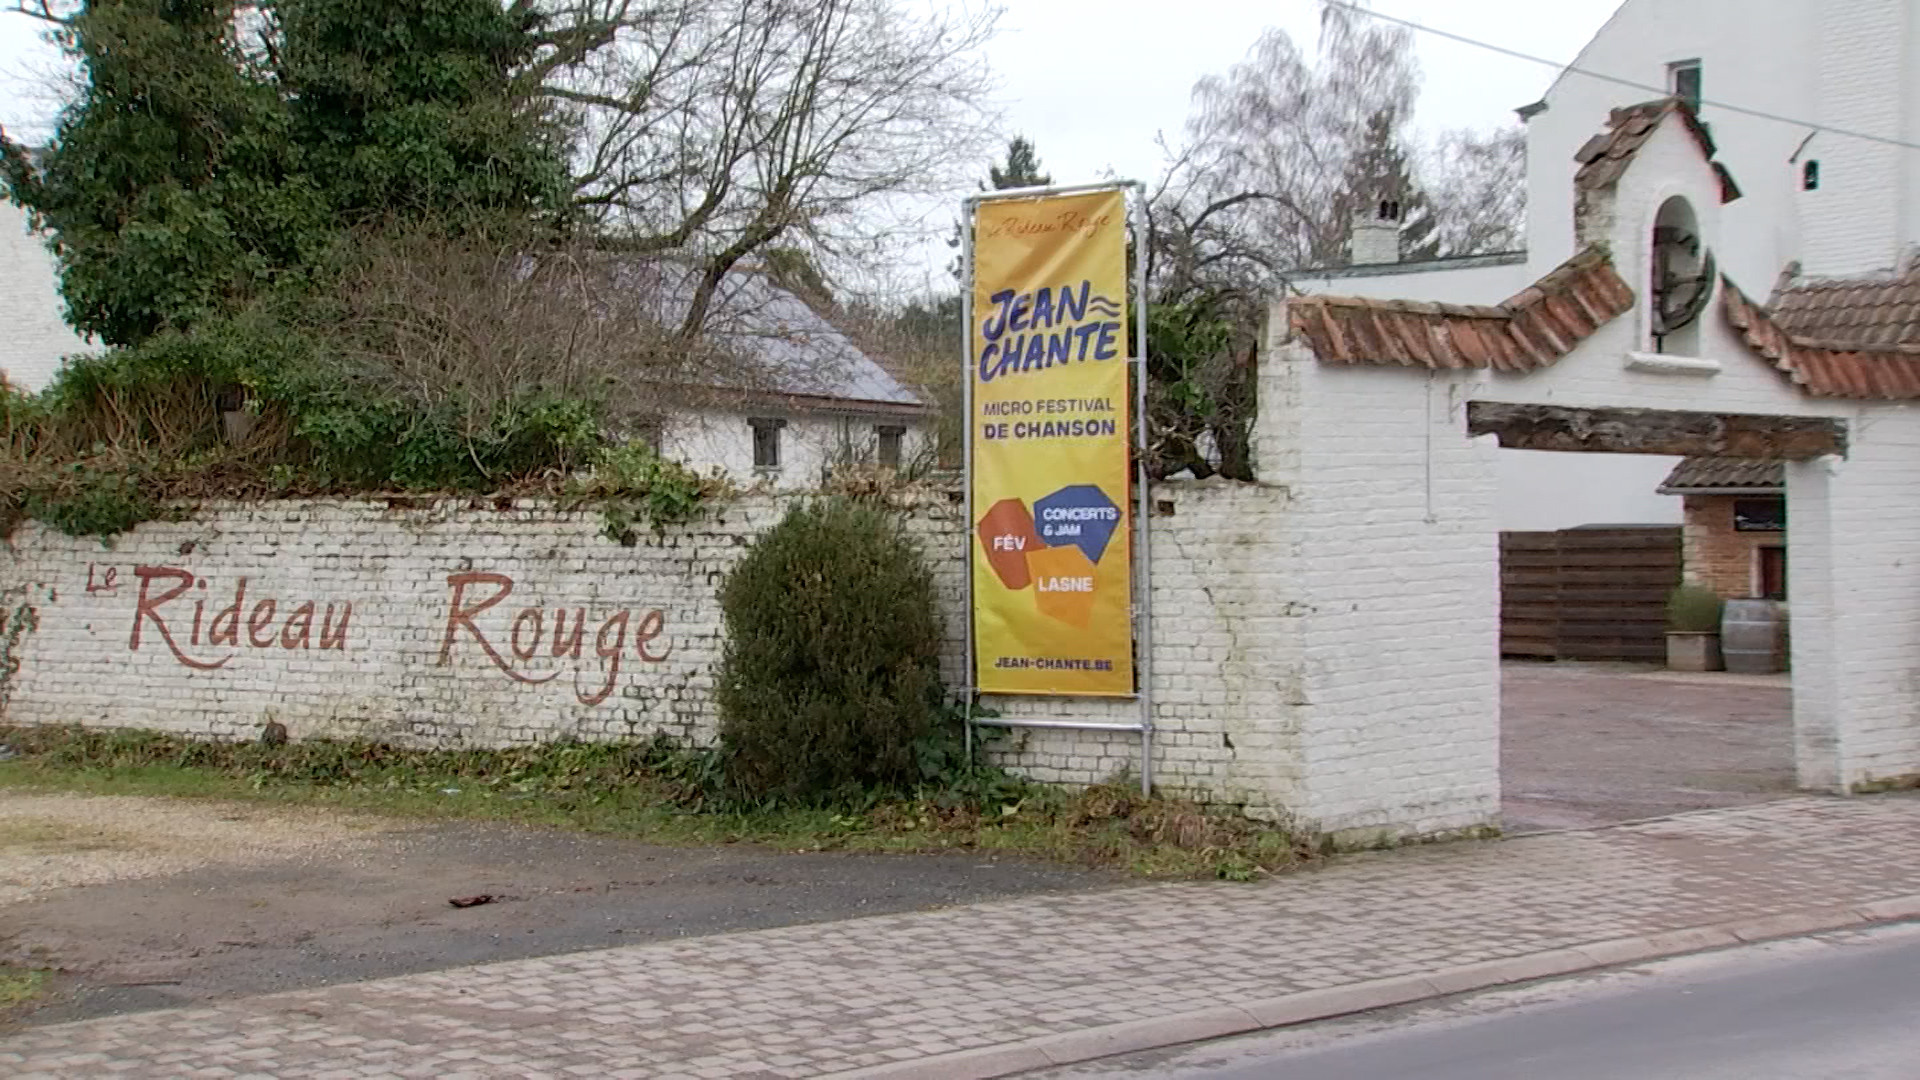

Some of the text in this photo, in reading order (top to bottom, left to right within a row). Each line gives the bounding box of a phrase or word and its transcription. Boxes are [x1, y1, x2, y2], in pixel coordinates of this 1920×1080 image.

[984, 280, 1090, 341] JEAN
[980, 322, 1121, 381] CHANTE
[984, 398, 1115, 416] MICRO FESTIVAL
[984, 419, 1115, 439] DE CHANSON
[1043, 507, 1116, 520] CONCERTS
[1043, 524, 1080, 536] & JAM
[993, 533, 1026, 551] FÉV
[1039, 576, 1093, 592] LASNE
[85, 561, 673, 705] Le Rideau Rouge
[995, 657, 1112, 671] JEAN-CHANTE.BE
